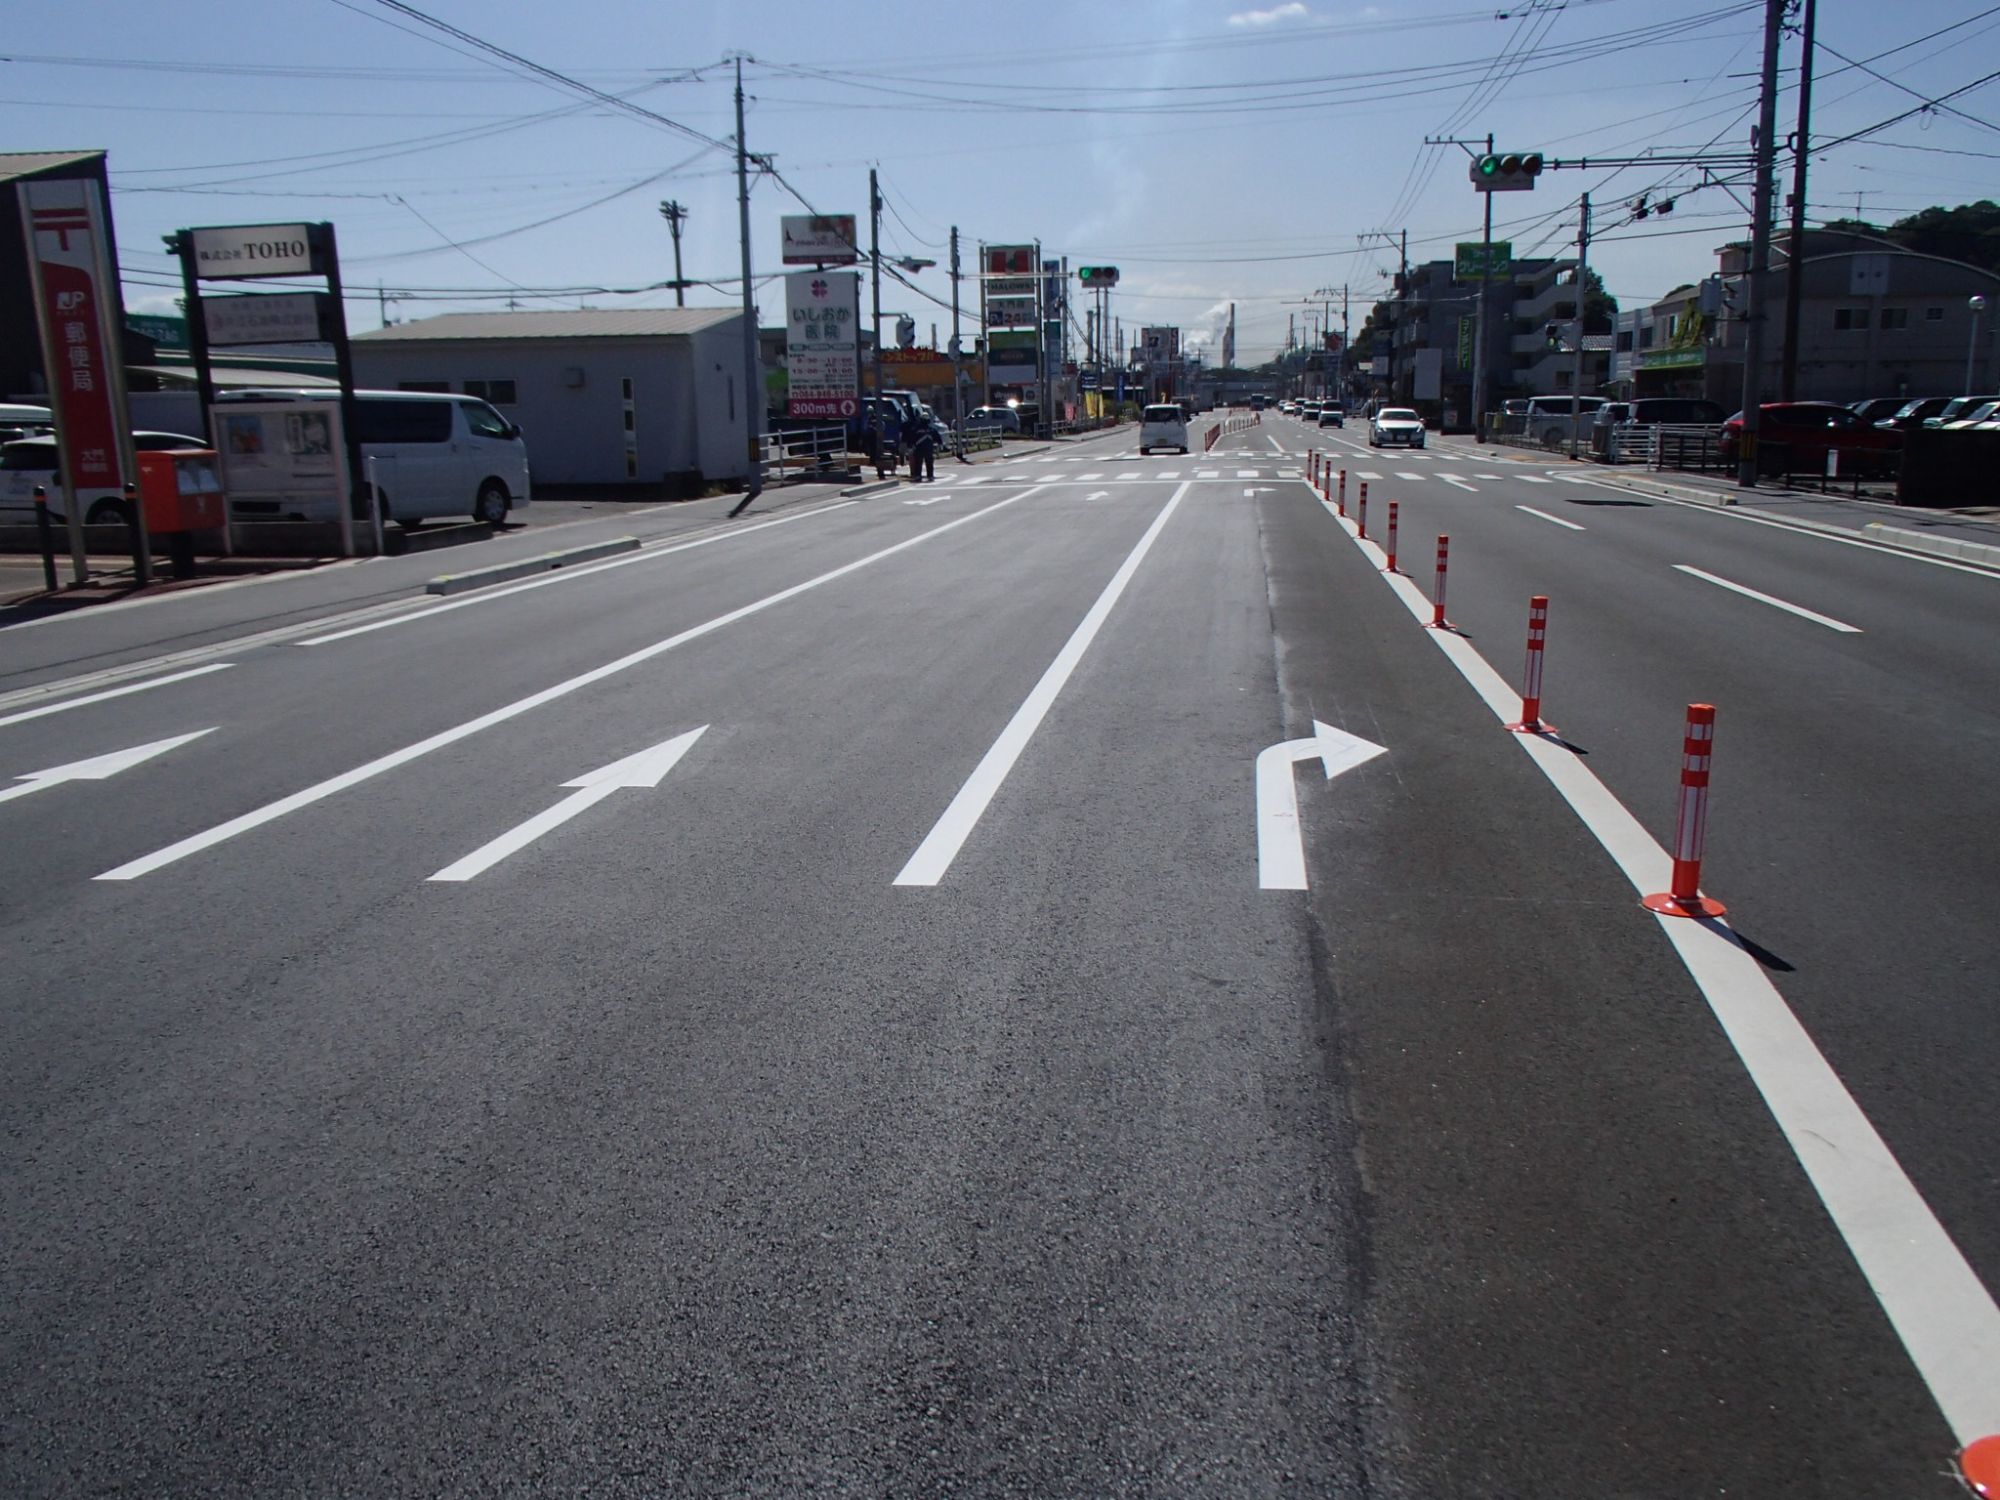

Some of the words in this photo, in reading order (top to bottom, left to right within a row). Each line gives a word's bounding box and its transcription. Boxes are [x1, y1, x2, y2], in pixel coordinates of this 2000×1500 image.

[244, 240, 306, 260] TOHO
[1458, 260, 1509, 274] クリーング
[793, 307, 850, 323] いしおか
[805, 324, 840, 340] 医院
[64, 321, 94, 392] 郵便局
